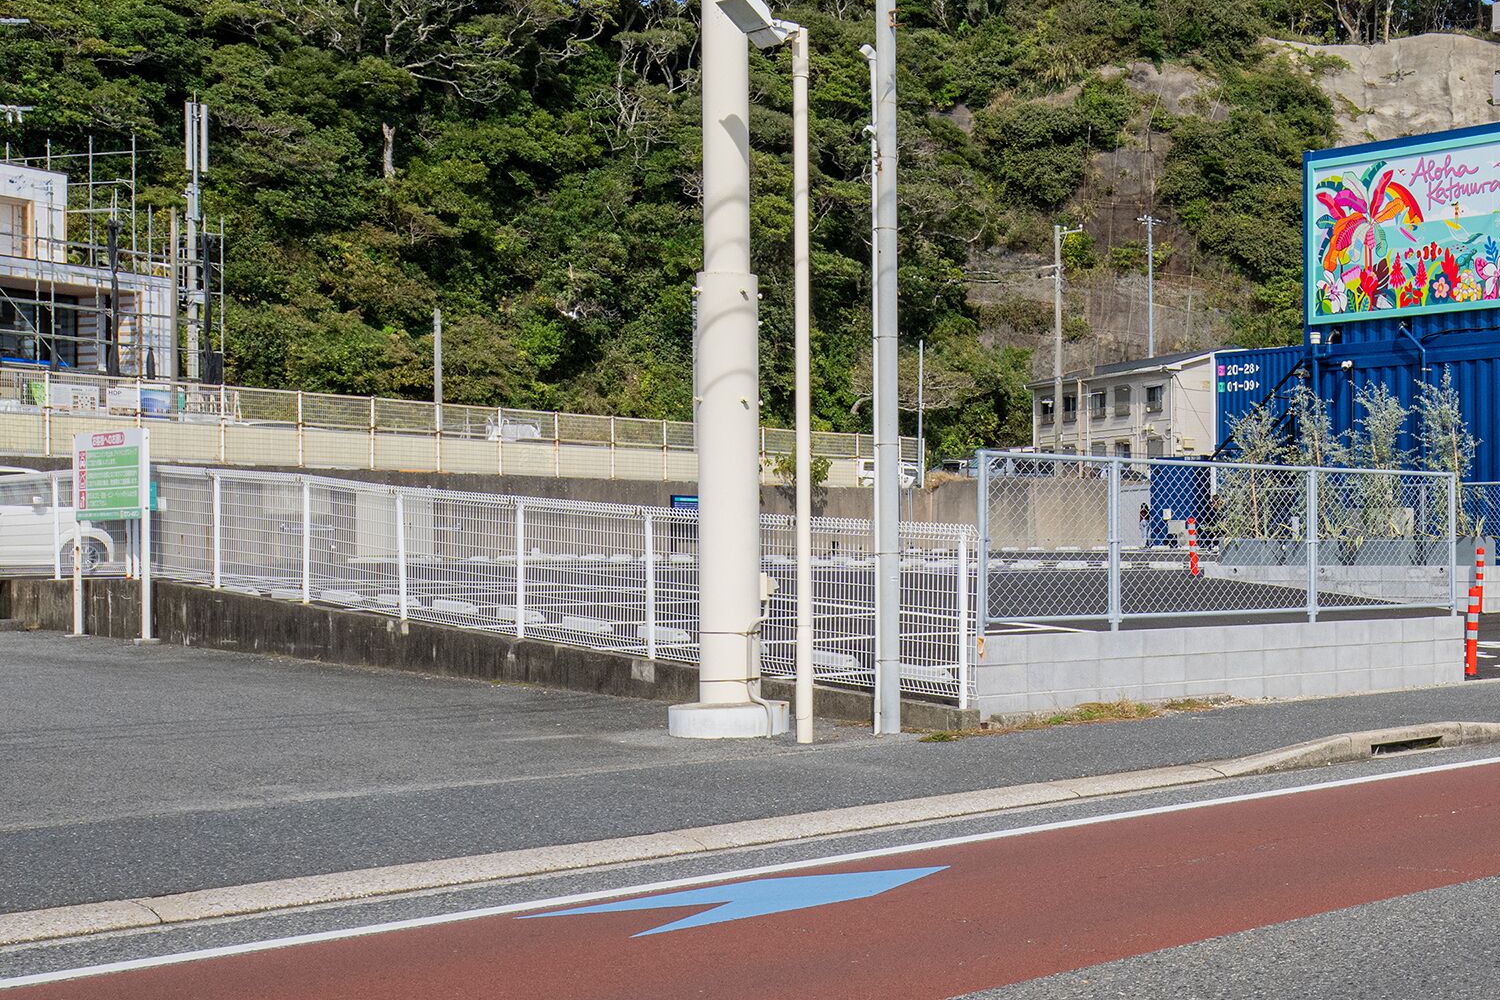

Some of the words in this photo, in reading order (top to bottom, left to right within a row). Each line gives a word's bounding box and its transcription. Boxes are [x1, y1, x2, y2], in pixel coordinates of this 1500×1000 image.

[1409, 154, 1479, 187] Aloha
[1227, 363, 1255, 376] 20-28
[1227, 380, 1255, 393] 01-09
